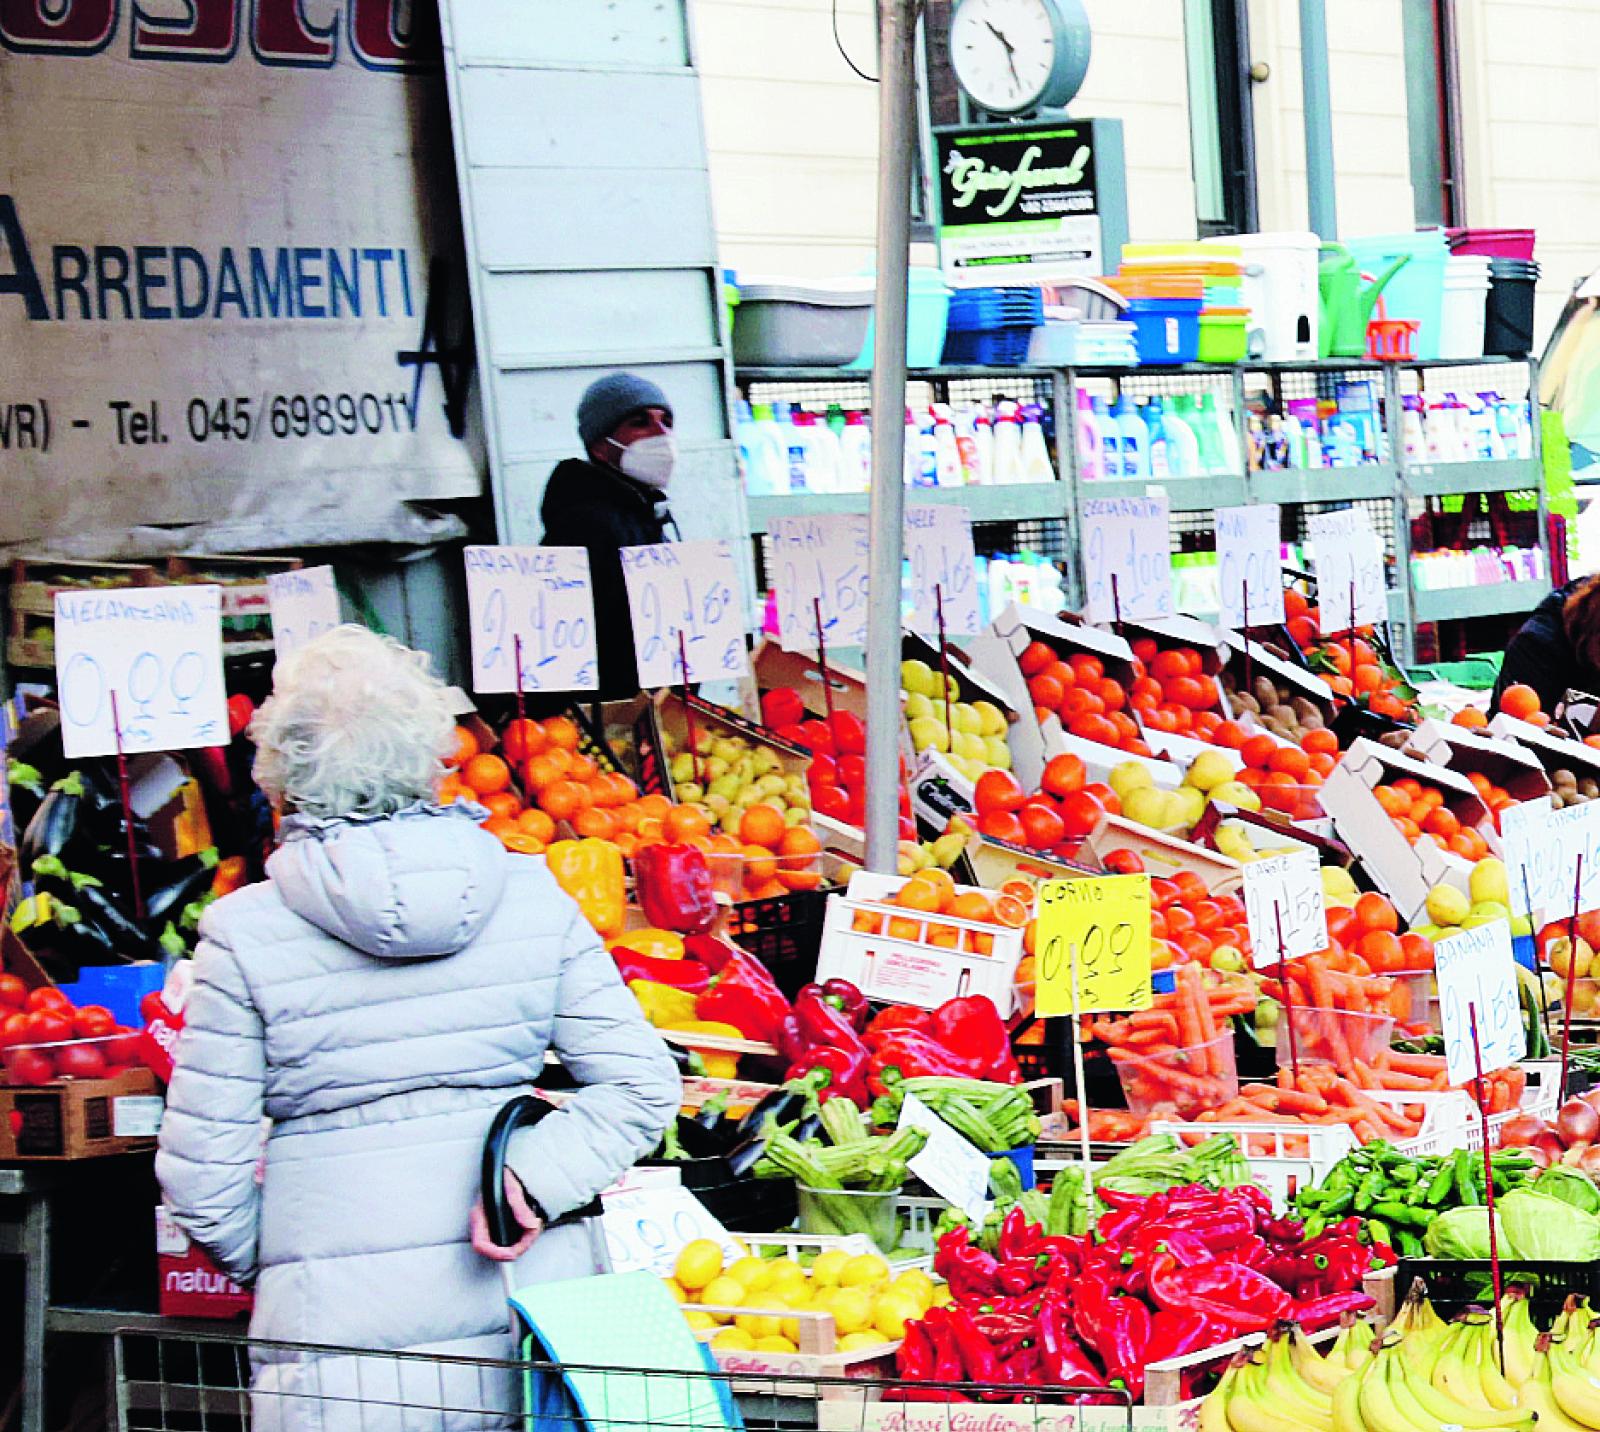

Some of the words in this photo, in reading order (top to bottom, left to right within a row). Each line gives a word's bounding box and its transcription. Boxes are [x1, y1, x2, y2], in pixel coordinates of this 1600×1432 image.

[0, 195, 415, 320] ARREDAMENTI
[110, 401, 168, 444] Tel.
[1436, 927, 1495, 971] BANANA
